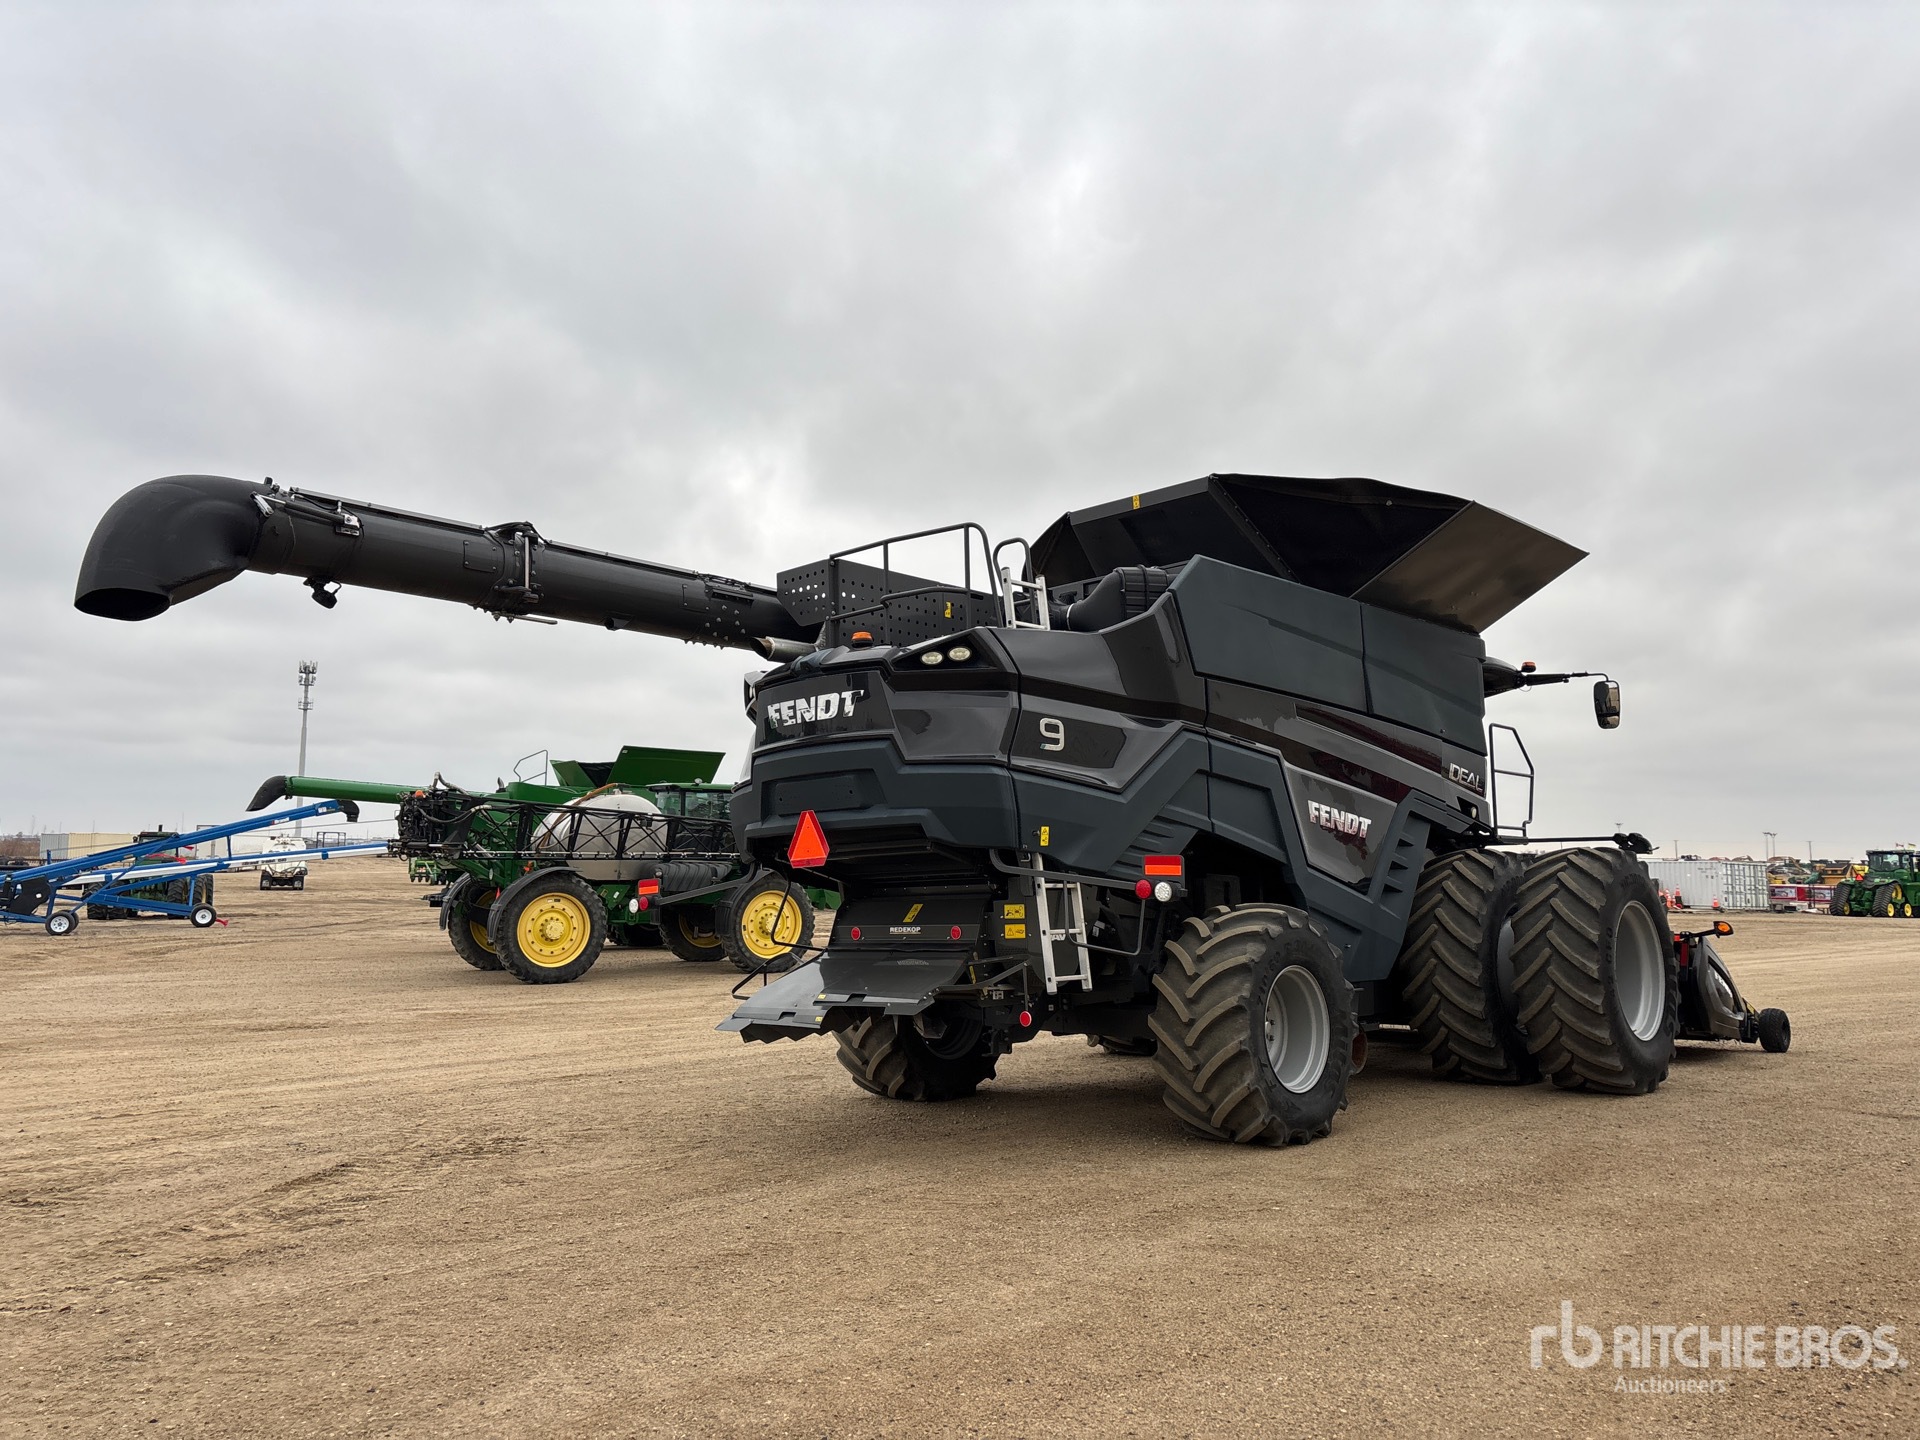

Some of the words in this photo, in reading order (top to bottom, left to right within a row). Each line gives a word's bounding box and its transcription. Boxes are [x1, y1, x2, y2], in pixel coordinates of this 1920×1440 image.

[767, 689, 865, 729] FENDT
[1039, 717, 1065, 751] 9
[1448, 762, 1483, 793] IDEAL
[1307, 799, 1372, 838] FENDT
[889, 926, 922, 934] REDEKOP
